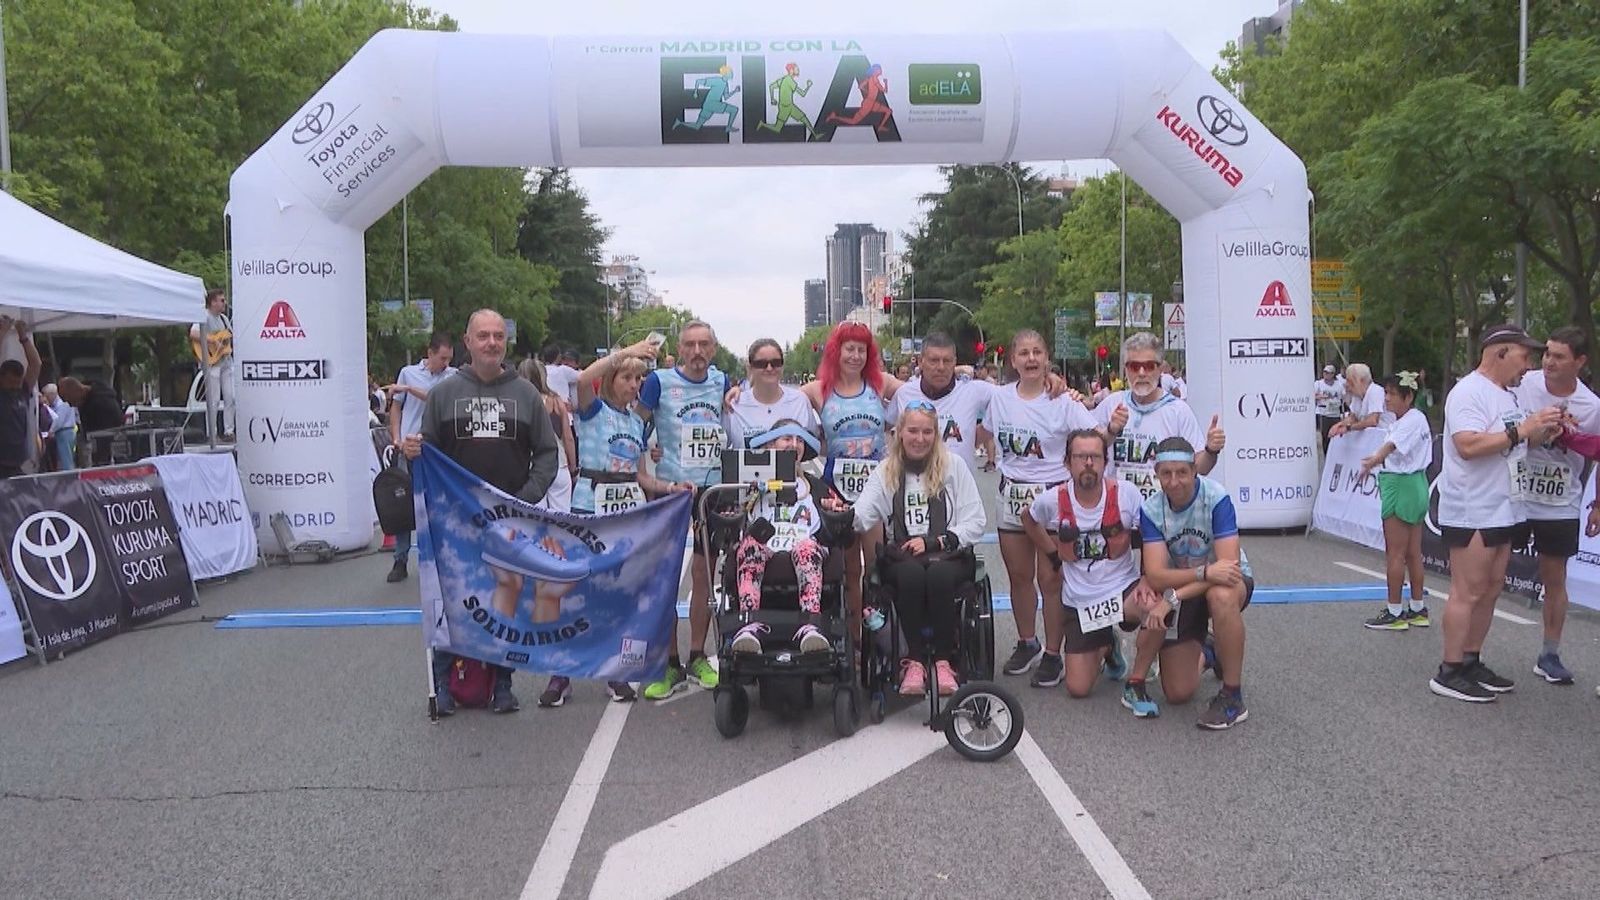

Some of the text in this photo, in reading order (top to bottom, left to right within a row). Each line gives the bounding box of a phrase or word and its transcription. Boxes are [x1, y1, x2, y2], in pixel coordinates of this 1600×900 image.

[599, 45, 653, 53] Carrera
[660, 41, 761, 52] MADRID
[769, 40, 823, 52] CON
[831, 40, 862, 51] LA
[661, 55, 902, 144] ELA
[308, 123, 359, 168] Toyota
[322, 123, 389, 184] Financial
[337, 144, 396, 198] Services
[1256, 308, 1296, 317] AXALTA
[260, 329, 306, 339] AXALTA
[1231, 340, 1304, 356] REFIX
[243, 362, 319, 379] REFIX
[320, 420, 330, 428] DE
[280, 430, 324, 439] HORTALEZA
[692, 428, 719, 440] ELA
[688, 443, 721, 458] 1576
[998, 432, 1045, 459] ELA
[1113, 438, 1158, 464] ELA
[843, 463, 869, 475] ELA
[840, 477, 868, 492] 198
[1126, 473, 1153, 486] ELA
[1529, 477, 1565, 496] 1506
[606, 487, 634, 500] ELA
[907, 494, 929, 506] EL
[1010, 486, 1035, 500] ELA
[1261, 485, 1313, 500] MADRID
[103, 498, 159, 526] TOYOTA
[269, 512, 336, 528] DRID
[112, 525, 173, 556] KURUMA
[122, 555, 168, 585] SPORT
[1084, 597, 1120, 621] 1235
[88, 621, 94, 633] 3
[94, 614, 118, 631] Madrid
[463, 596, 590, 646] SOLIDARIOS
